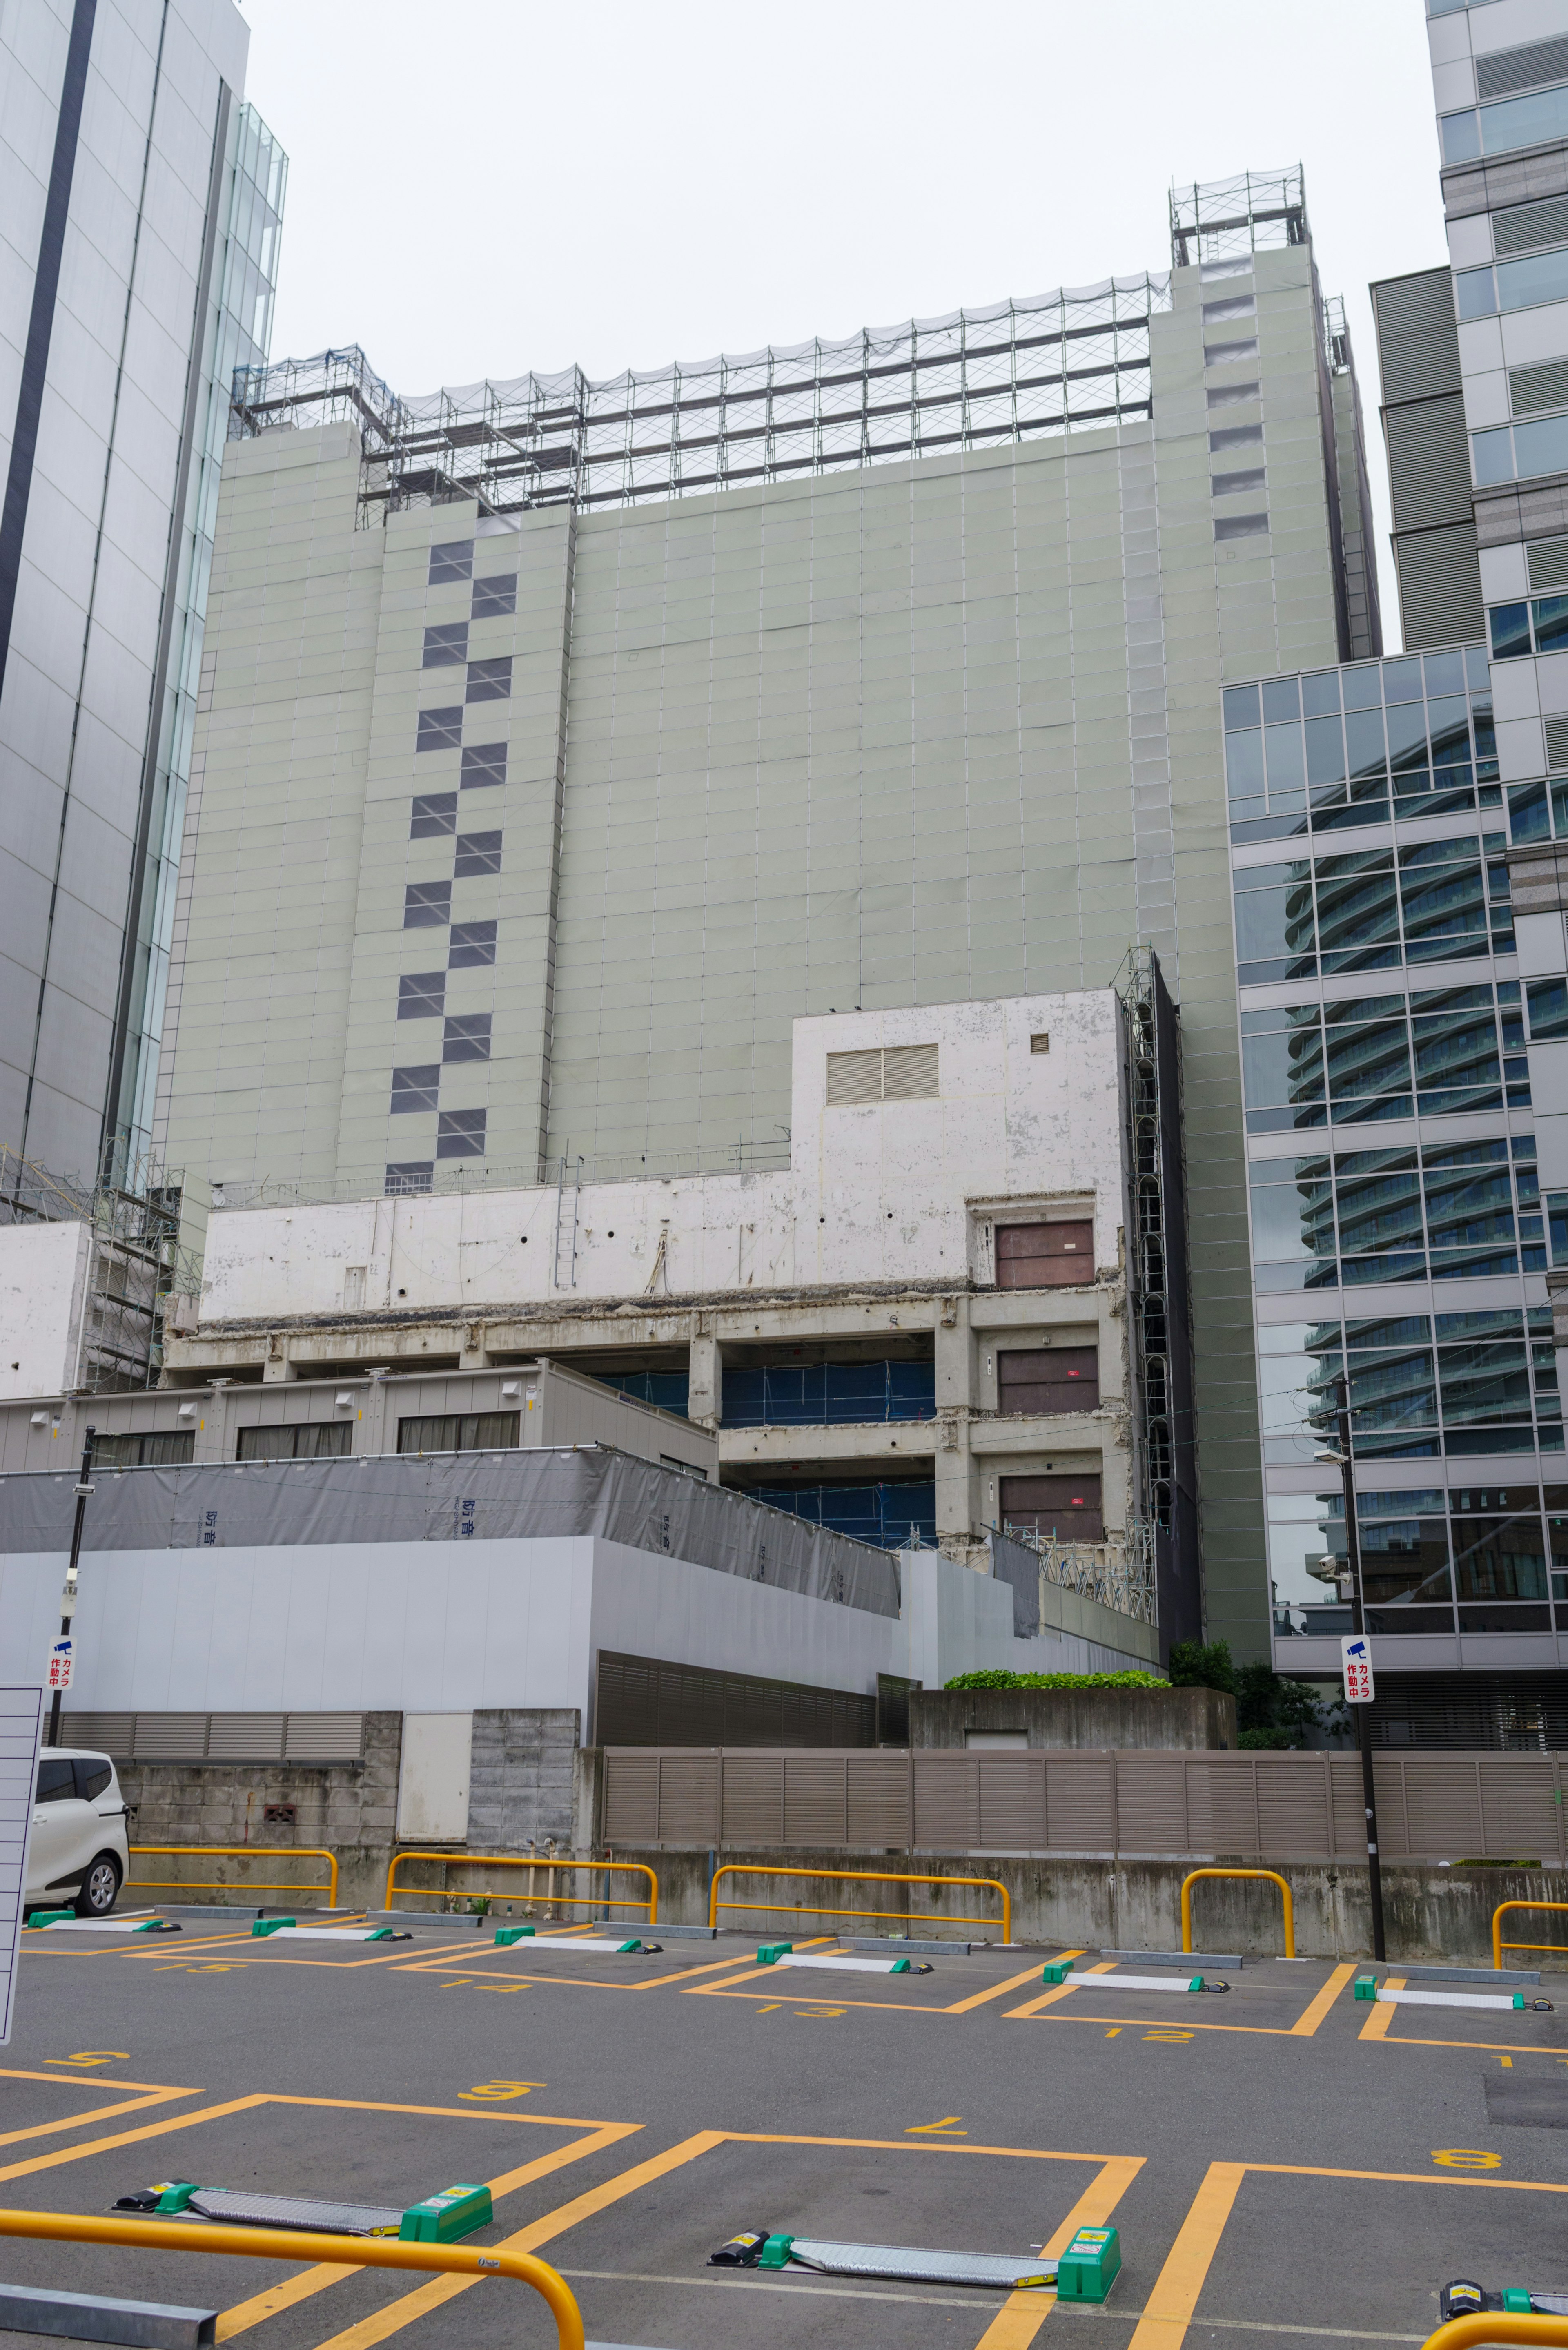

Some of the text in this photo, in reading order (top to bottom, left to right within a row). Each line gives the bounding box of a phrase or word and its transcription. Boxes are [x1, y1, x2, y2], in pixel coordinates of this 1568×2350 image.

[204, 1511, 217, 1546] 防音
[461, 1500, 475, 1536] 防音
[663, 1515, 670, 1551] 防音
[49, 1659, 60, 1686] 作動中
[61, 1659, 71, 1686] カメラ
[1347, 1664, 1358, 1698] 作動中
[1359, 1664, 1370, 1697] カメラ
[154, 1964, 247, 1973] 15
[440, 1979, 532, 1992] 14
[756, 2004, 848, 2018] 13
[1105, 2027, 1195, 2044] 12
[43, 2051, 131, 2067] 5
[904, 2116, 968, 2136] 7
[1430, 2149, 1503, 2169] 8
